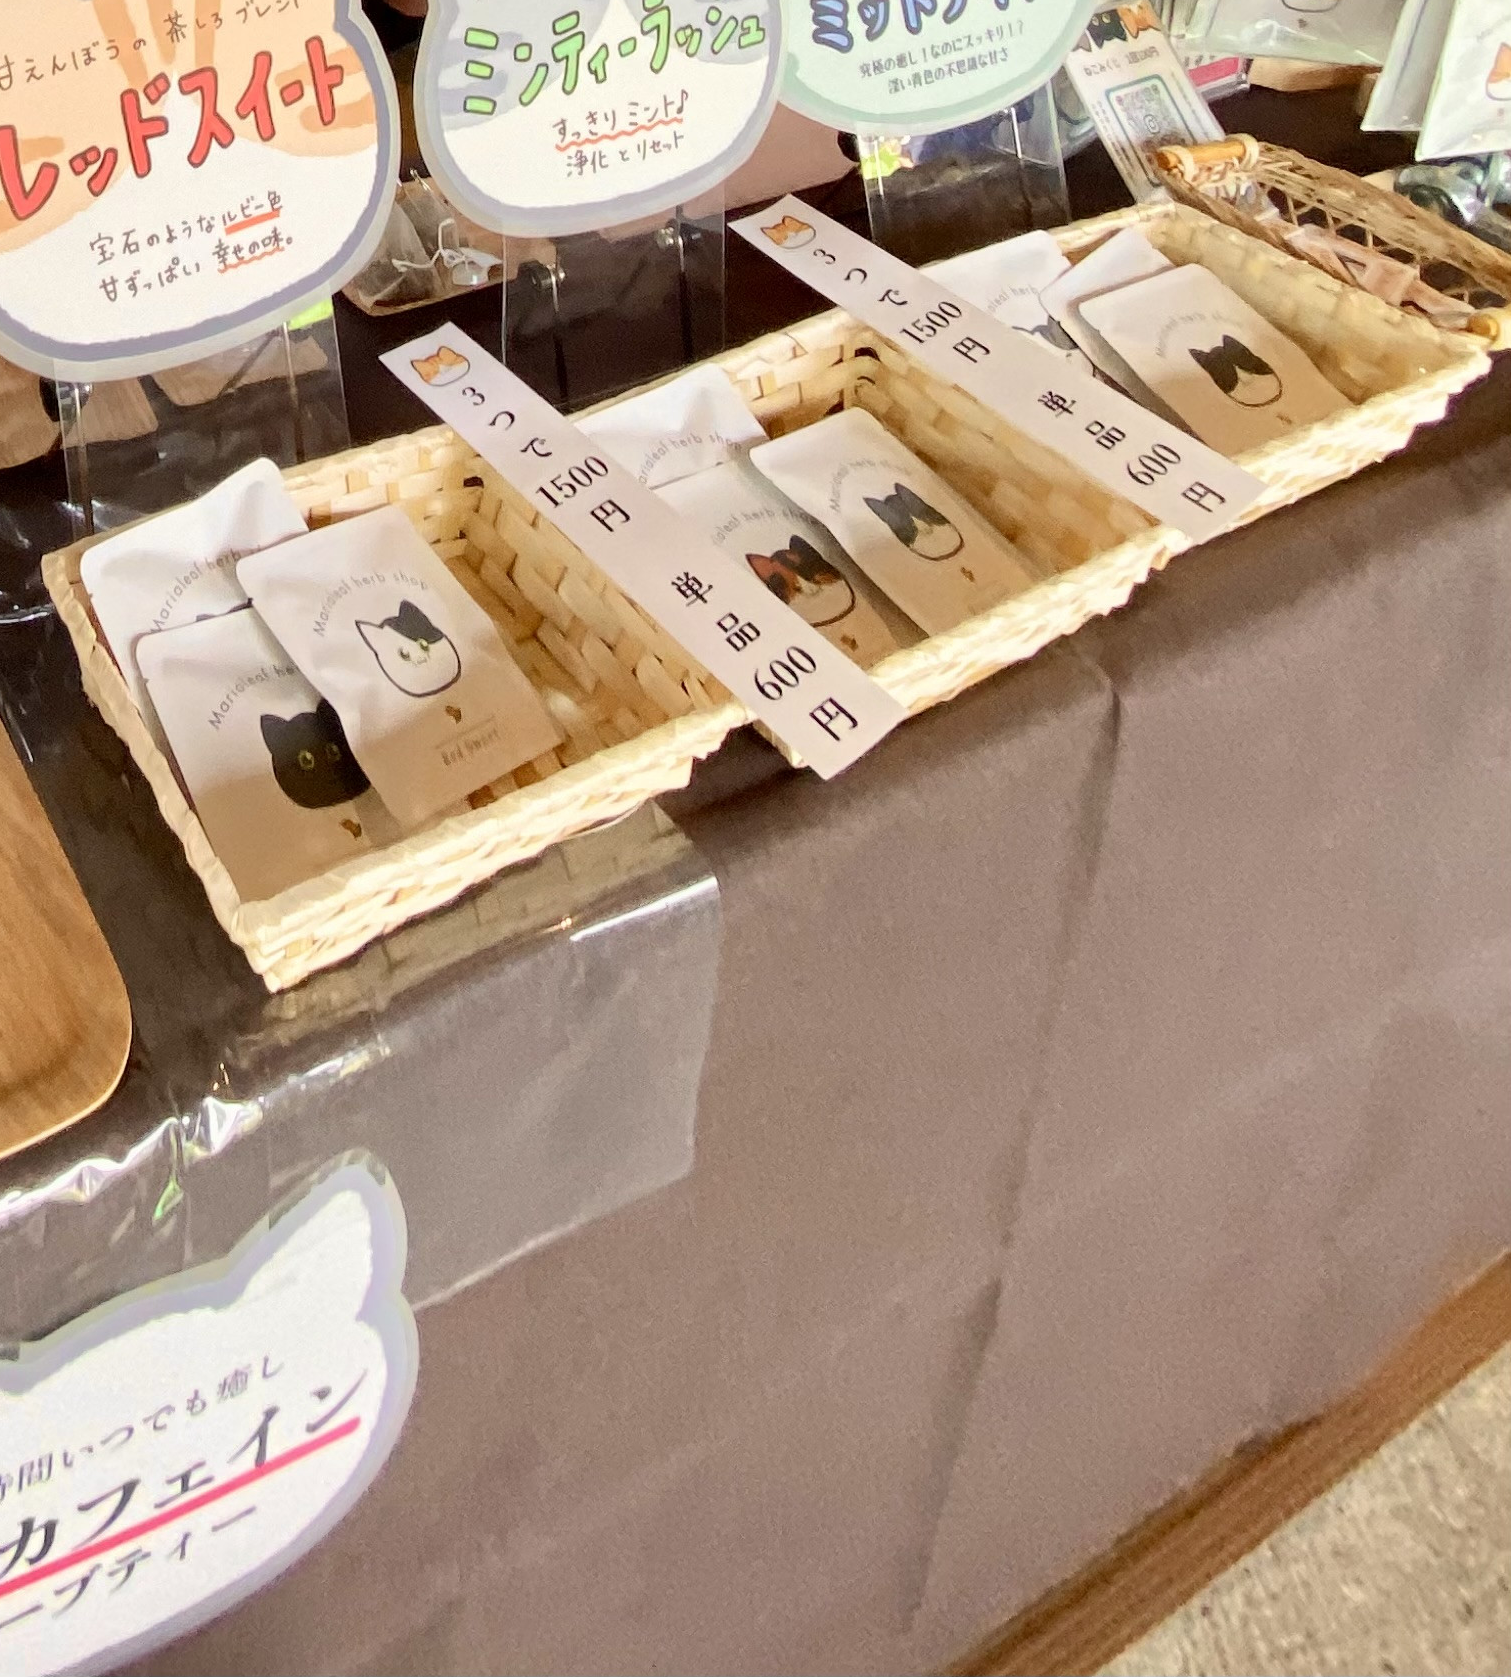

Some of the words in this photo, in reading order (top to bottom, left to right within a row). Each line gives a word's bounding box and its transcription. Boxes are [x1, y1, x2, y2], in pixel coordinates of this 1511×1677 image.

[90, 190, 283, 265] 宝石のようなルビー色
[640, 437, 670, 484] arialeaf
[353, 571, 387, 589] herb
